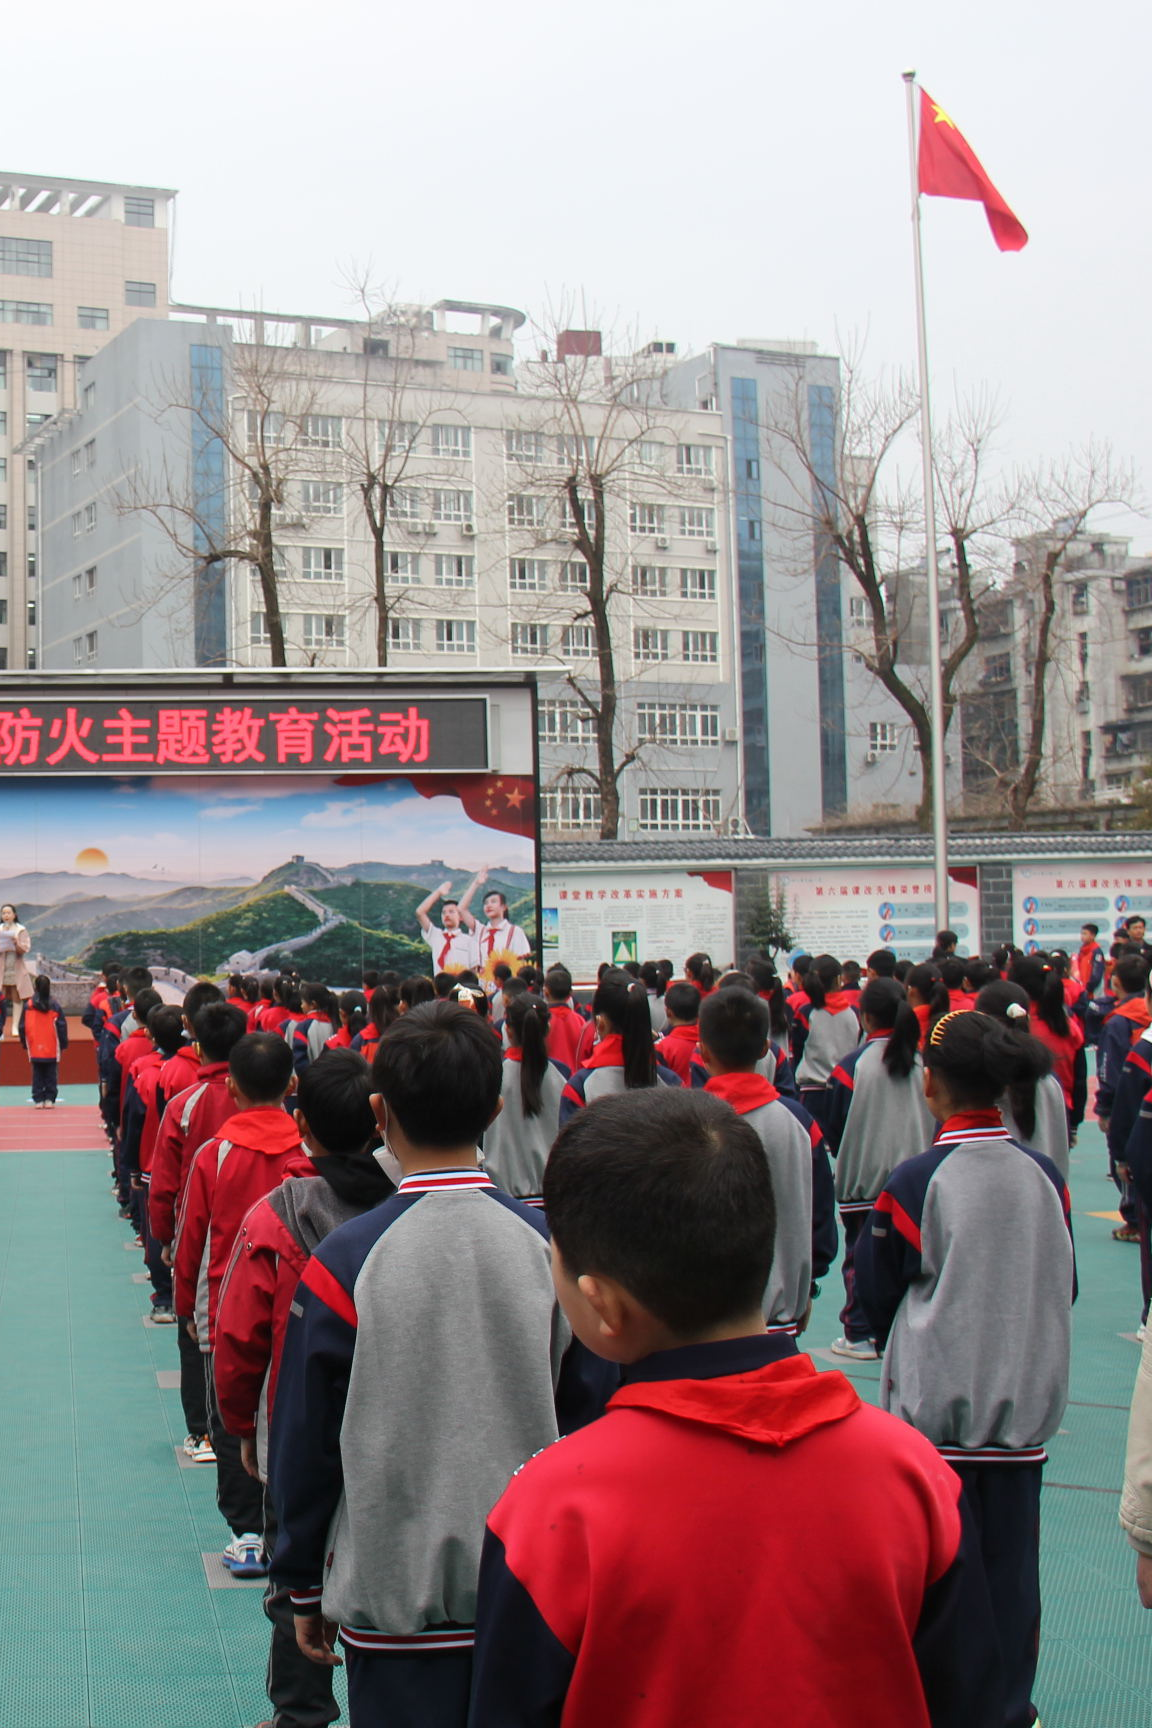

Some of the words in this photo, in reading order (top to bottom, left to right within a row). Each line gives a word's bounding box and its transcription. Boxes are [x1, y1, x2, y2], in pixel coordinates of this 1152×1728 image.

[559, 888, 684, 900] 课堂教学改革实施方案
